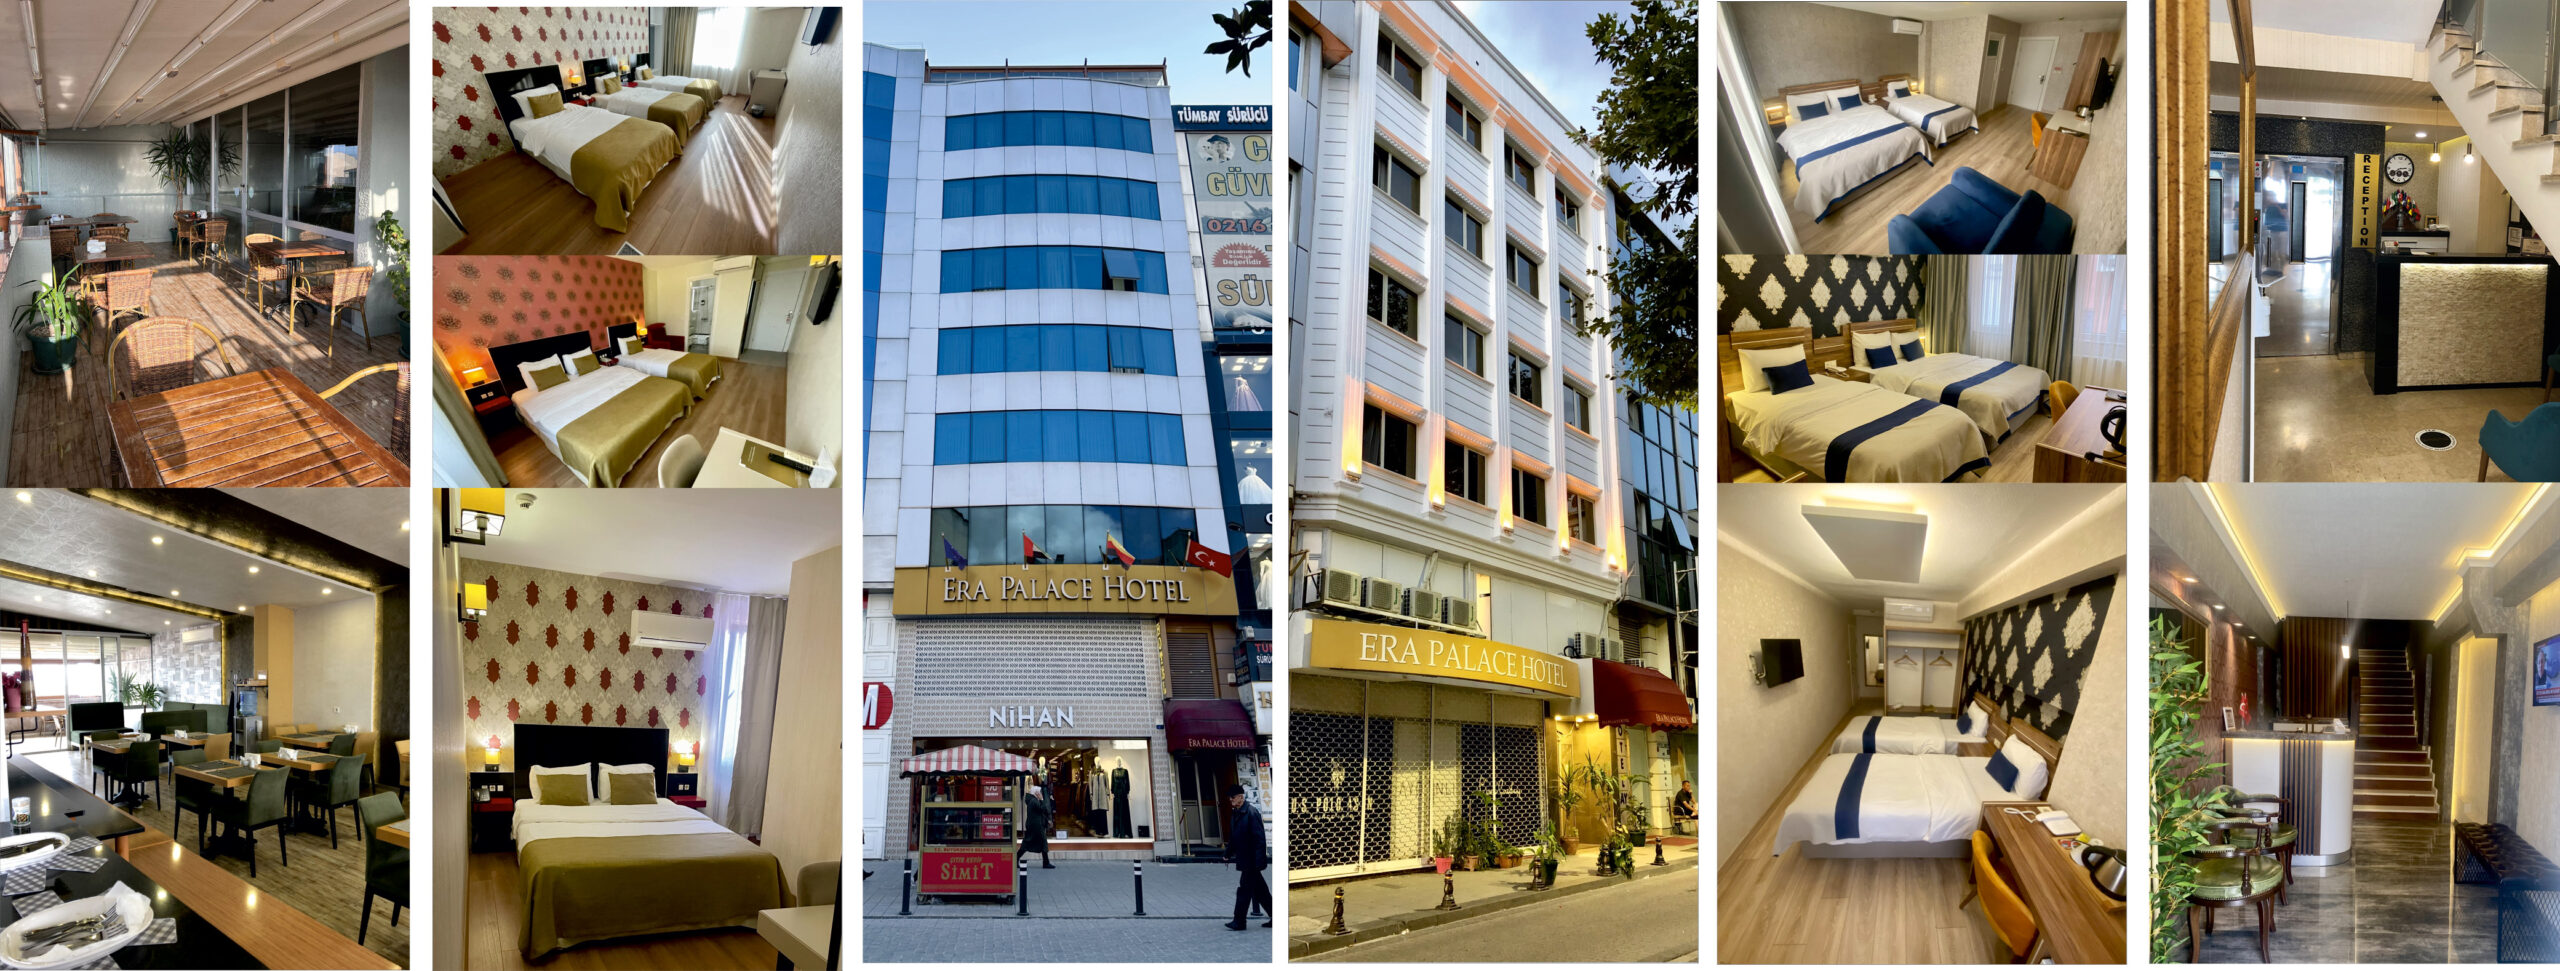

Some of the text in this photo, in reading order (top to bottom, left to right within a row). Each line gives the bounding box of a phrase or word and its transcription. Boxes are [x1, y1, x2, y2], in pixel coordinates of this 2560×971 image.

[1178, 107, 1269, 123] TÜMBAY SÜRÜCÜ
[1243, 135, 1272, 164] Ç
[2360, 154, 2371, 246] RECEPTION
[1207, 218, 1267, 232] 0216
[943, 575, 1191, 602] ERA PALACE HOTEL
[1359, 632, 1568, 688] ERA PALACE HOTEL
[1188, 738, 1249, 748] ERA PALACE HOTEL
